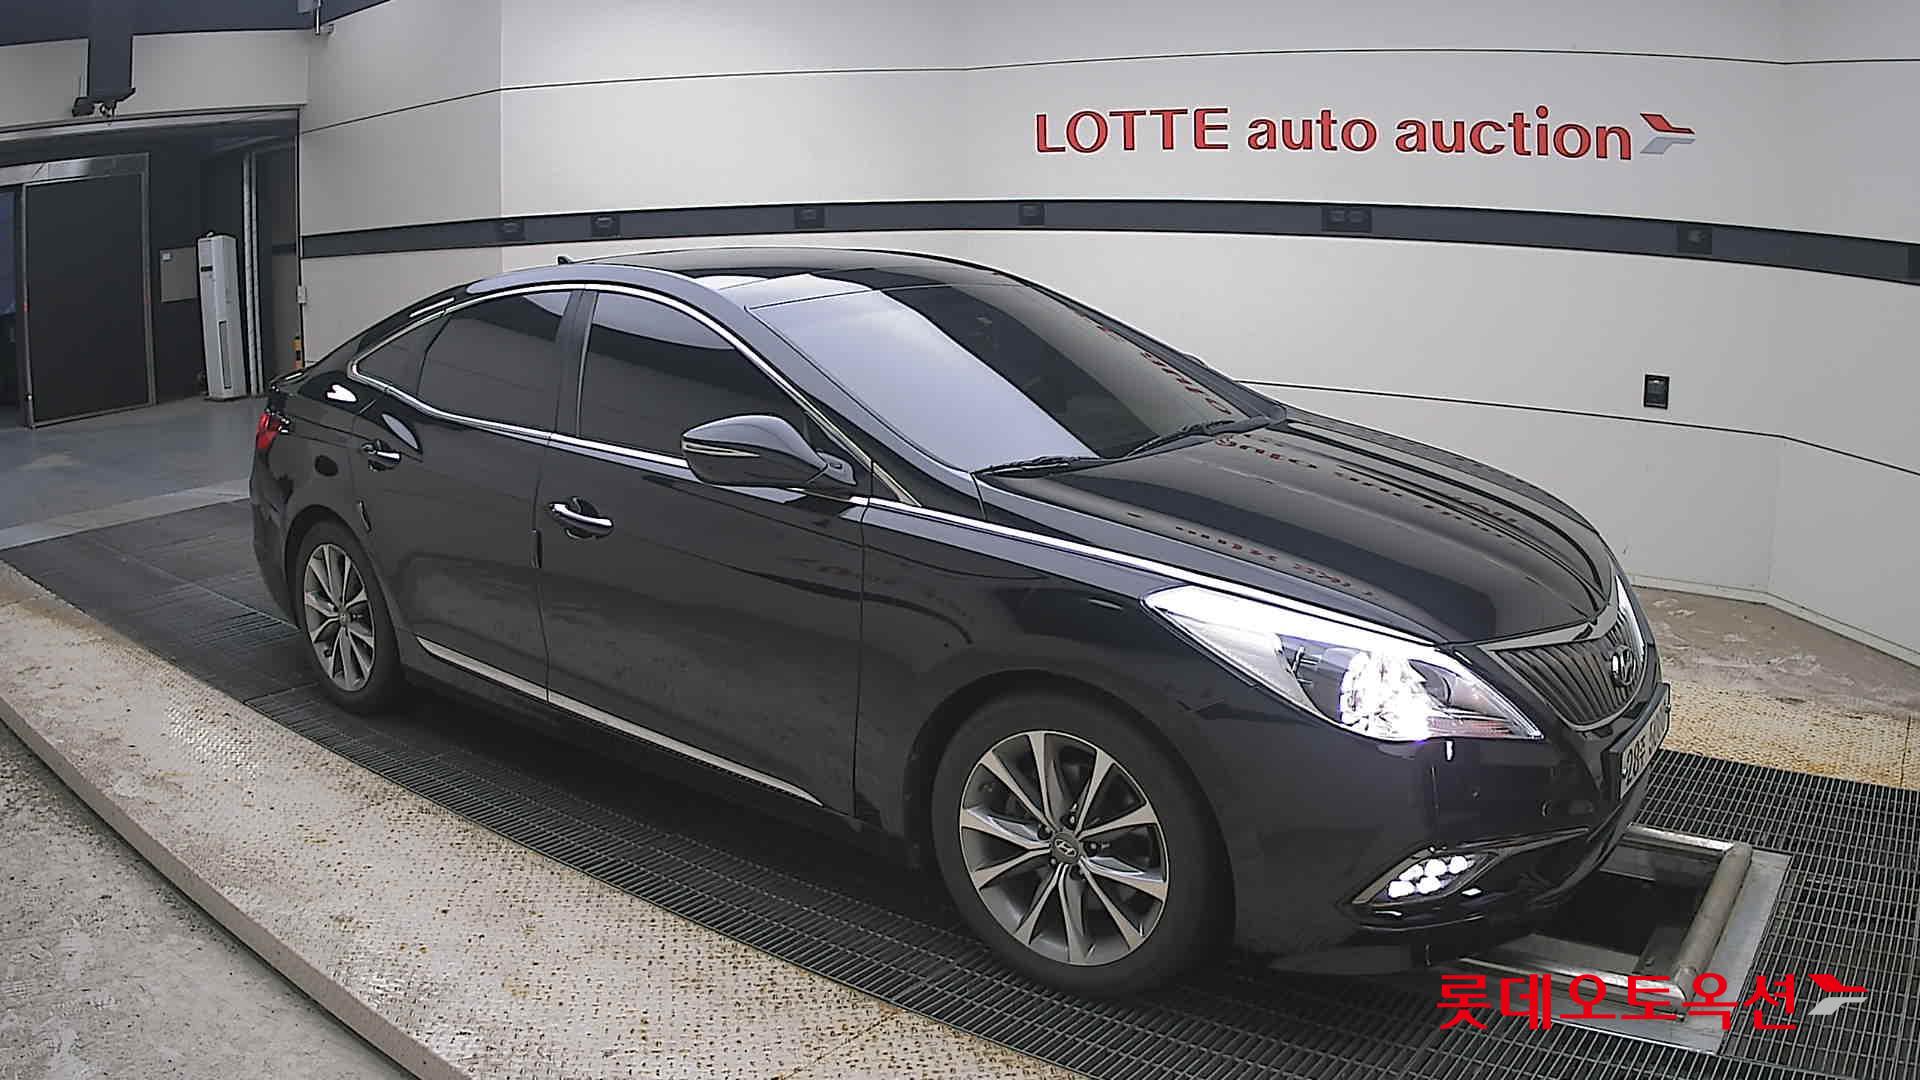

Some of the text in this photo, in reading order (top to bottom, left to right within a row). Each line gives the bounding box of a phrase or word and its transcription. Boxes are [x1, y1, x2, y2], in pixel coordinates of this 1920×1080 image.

[1036, 105, 1632, 160] LOTTE auto auction
